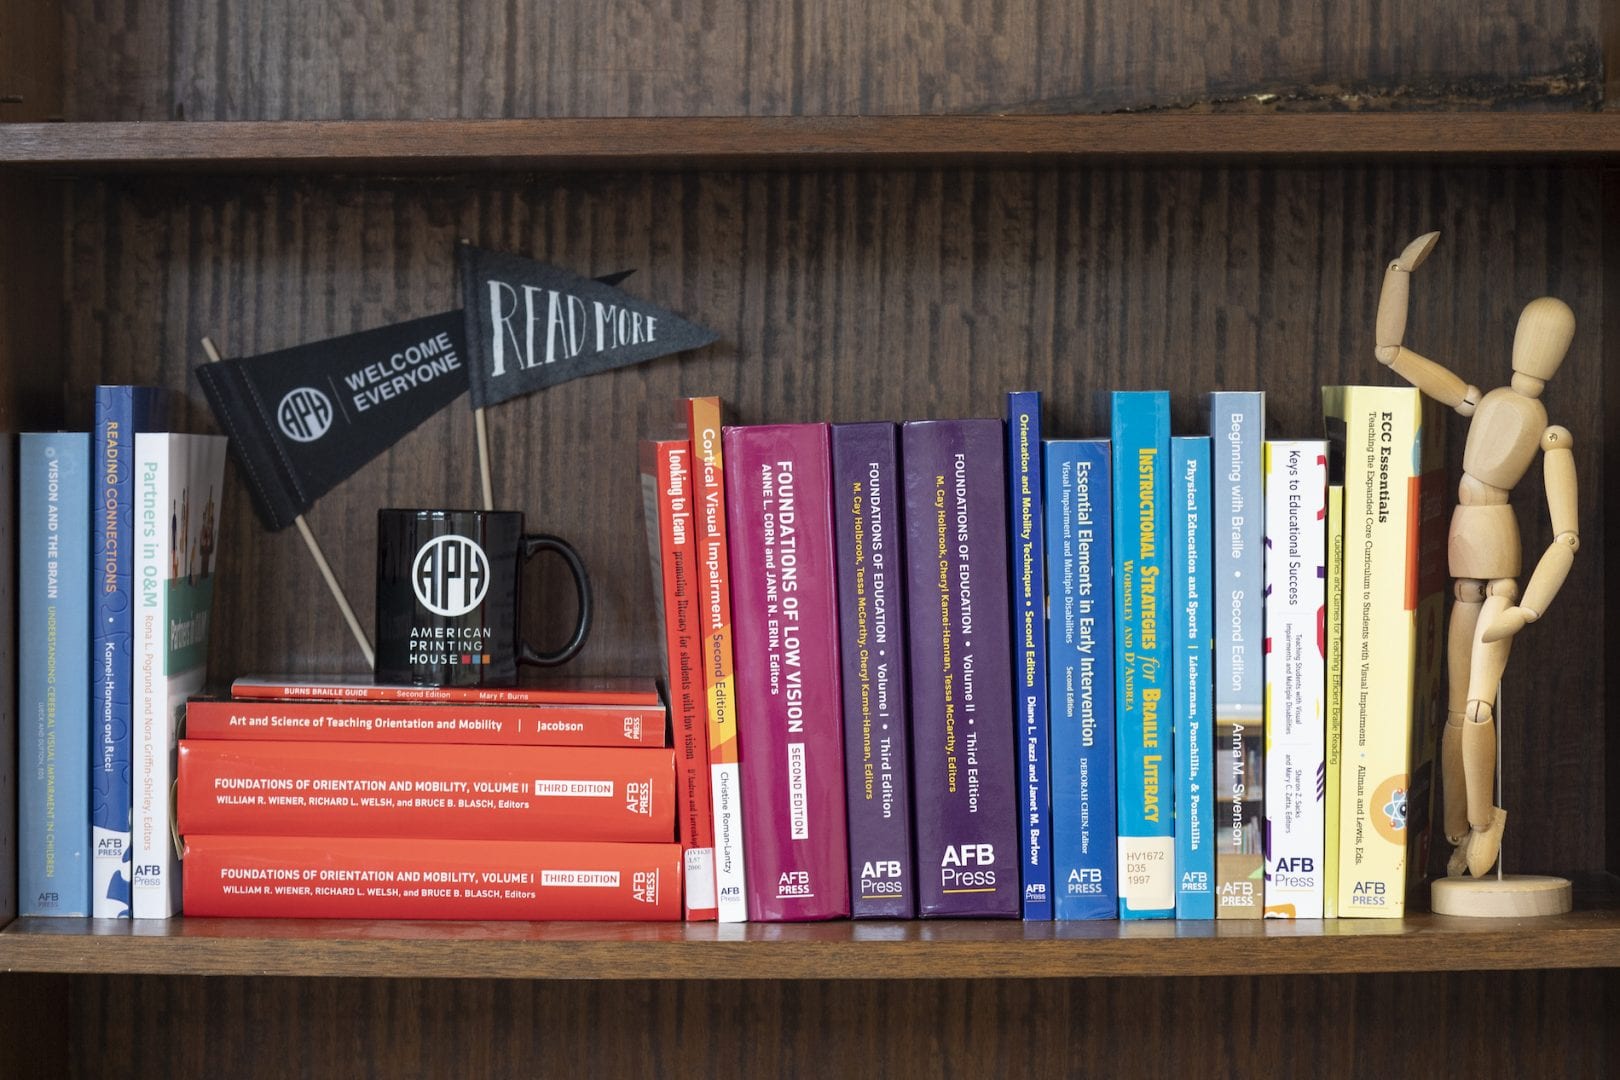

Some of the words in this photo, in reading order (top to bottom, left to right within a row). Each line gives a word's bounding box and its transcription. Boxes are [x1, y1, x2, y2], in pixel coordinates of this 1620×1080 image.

[488, 280, 587, 377] READ
[593, 300, 657, 352] MORE
[345, 332, 454, 391] WELCOME
[353, 352, 461, 412] EVERYONE
[277, 388, 334, 443] APH
[1366, 411, 1376, 452] Teaching
[1381, 412, 1391, 441] ECC
[107, 422, 117, 483] READING
[702, 428, 717, 486] Cortical
[1020, 414, 1029, 472] Orientation
[1229, 413, 1242, 480] Beginning
[48, 459, 57, 500] VISION
[668, 449, 686, 495] Looking
[1287, 450, 1300, 475] Keys
[144, 462, 157, 536] Partners
[955, 454, 967, 540] FOUNDATIONS
[1021, 475, 1030, 493] and
[1077, 462, 1092, 524] Essential
[1186, 459, 1196, 510] Physical
[1232, 485, 1242, 511] with
[1289, 479, 1299, 490] to
[1365, 470, 1374, 514] Expanded
[1378, 446, 1390, 522] Essentials
[48, 505, 57, 530] AND
[671, 497, 685, 510] to
[706, 492, 720, 536] Visual
[869, 462, 881, 549] FOUNDATIONS
[1022, 497, 1031, 539] Mobility
[106, 488, 117, 592] CONNECTIONS
[672, 512, 688, 544] Learn
[777, 461, 796, 591] FOUNDATIONS
[1188, 513, 1197, 573] Education
[1232, 516, 1243, 558] Braille
[1289, 495, 1300, 557] Educational
[1365, 517, 1373, 538] Core
[48, 534, 57, 557] THE
[143, 543, 158, 558] in
[873, 553, 882, 568] OF
[958, 544, 968, 560] OF
[1078, 530, 1092, 594] Elements
[48, 561, 57, 597] BRAIN
[412, 535, 490, 616] APH
[1023, 542, 1032, 597] Techniques
[1364, 540, 1372, 589] Curriculum
[143, 565, 157, 606] O&M
[706, 542, 722, 628] Impairment
[959, 564, 971, 633] EDUCATION
[1188, 576, 1197, 598] and
[1289, 561, 1300, 604] Success
[1363, 591, 1370, 599] to
[783, 597, 798, 620] OF
[874, 573, 885, 642] EDUCATION
[1080, 600, 1093, 612] in
[1187, 601, 1197, 638] Sports
[1232, 590, 1243, 640] Second
[1362, 602, 1370, 638] Students
[144, 615, 153, 639] Rona
[411, 628, 491, 638] AMERICAN
[1025, 610, 1034, 647] Second
[1079, 618, 1094, 652] Early
[410, 641, 482, 651] PRINTING
[410, 654, 458, 664] HOUSE
[713, 634, 725, 676] Second
[784, 626, 800, 666] LOW
[105, 642, 114, 720] Kamei-Hannan
[143, 653, 153, 693] Pogrund
[963, 654, 973, 700] Volume
[1026, 651, 1035, 686] Edition
[1232, 645, 1243, 690] Edition
[1360, 663, 1368, 688] Visual
[345, 688, 367, 696] GUIDE
[715, 682, 726, 723] Edition
[786, 671, 802, 732] VISION
[877, 663, 887, 709] Volume
[1081, 658, 1096, 746] Intervention
[144, 696, 152, 714] and
[1358, 692, 1368, 746] Impairments
[105, 723, 113, 742] and
[144, 717, 152, 741] Nora
[229, 715, 245, 725] Art
[249, 716, 267, 725] and
[271, 716, 309, 726] Science
[312, 716, 323, 726] of
[326, 717, 371, 729] Teaching
[375, 717, 433, 727] Orientation
[436, 719, 455, 728] and
[459, 719, 501, 731] Mobility
[537, 720, 582, 731] Jacobson
[1232, 723, 1244, 757] Anna
[104, 746, 113, 771] Ricci
[967, 732, 977, 764] Third
[142, 744, 152, 813] Griffin-Shirley,
[214, 778, 292, 789] FOUNDATIONS
[296, 779, 309, 789] OF
[313, 780, 385, 790] ORIENTATION
[389, 781, 412, 790] AND
[415, 781, 469, 792] MOBILITY,
[473, 782, 518, 792] VOLUME
[522, 783, 528, 792] II
[792, 747, 801, 789] SECOND
[1232, 762, 1243, 778] M.
[538, 783, 567, 792] THIRD
[571, 784, 610, 792] EDITION
[626, 782, 638, 813] AFB
[640, 782, 649, 814] PRESS
[720, 771, 729, 809] Christine
[968, 768, 979, 812] Edition
[793, 793, 803, 834] EDITION
[1232, 784, 1244, 845] Swenson
[144, 816, 152, 850] Editors
[722, 812, 731, 873] Roman-Lantzy
[135, 865, 160, 875] AFB
[861, 861, 901, 878] AFB
[941, 844, 995, 866] AFB
[1127, 851, 1164, 861] HV1672
[1128, 863, 1146, 872] D35
[1276, 857, 1314, 872] AFB
[135, 876, 160, 886] Press
[221, 868, 299, 879] FOUNDATIONS
[302, 870, 316, 879] OF
[320, 870, 393, 880] ORIENTATION
[396, 871, 419, 881] AND
[423, 872, 478, 883] MOBILITY,
[482, 872, 527, 882] VOLUME
[530, 873, 533, 882] I
[721, 887, 740, 895] AFB
[779, 871, 809, 884] AFB
[779, 885, 809, 894] PRESS
[861, 879, 902, 892] Press
[942, 869, 995, 886] Press
[1128, 875, 1150, 885] 1997
[1276, 873, 1314, 887] Press
[1354, 881, 1385, 894] AFB
[38, 893, 59, 901] AFB
[1353, 896, 1385, 905] PRESS
